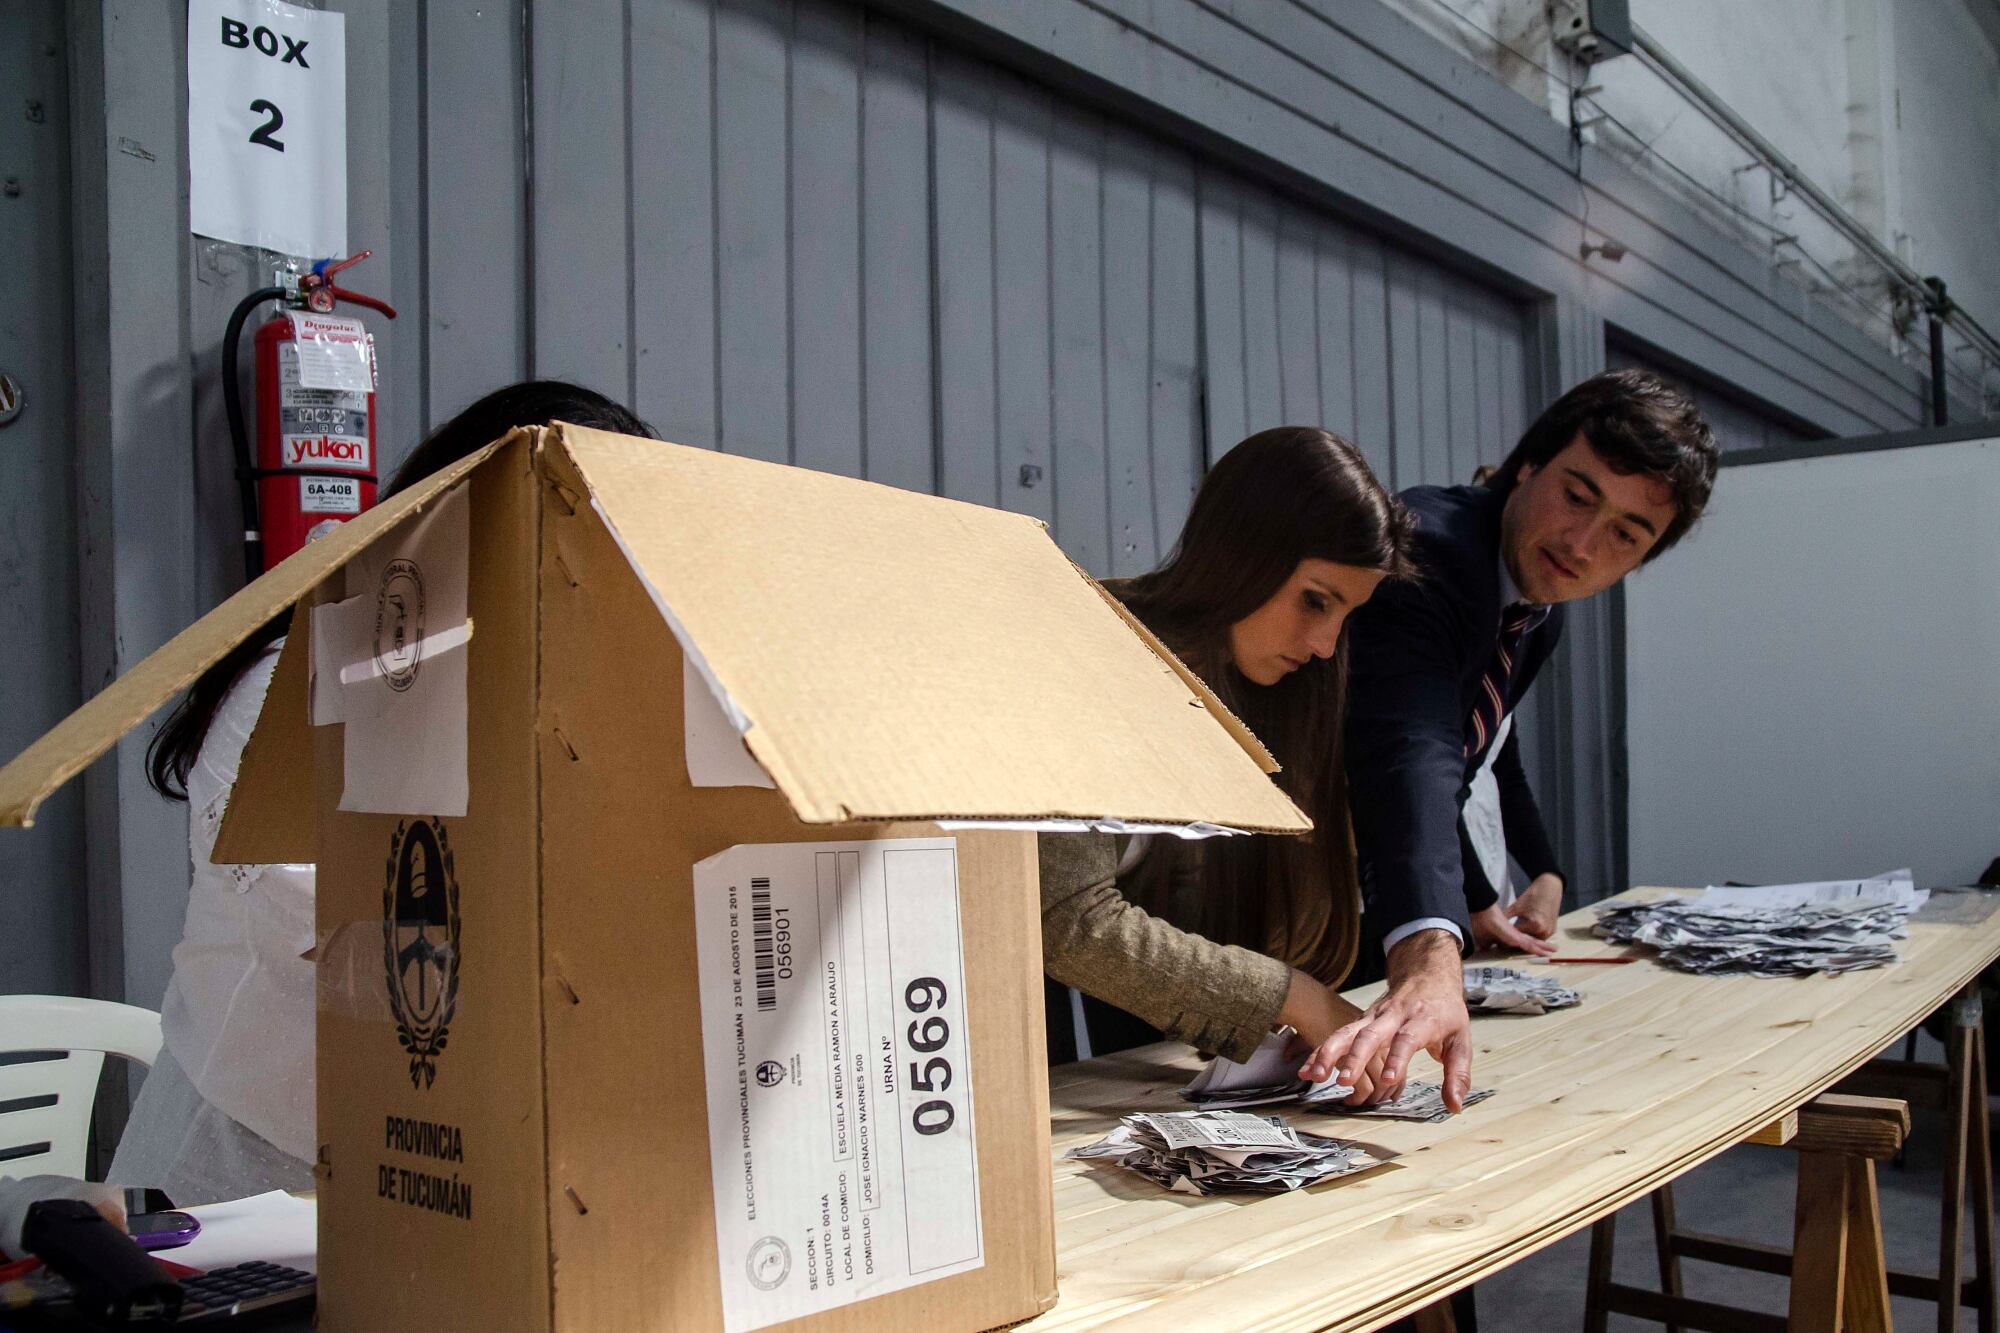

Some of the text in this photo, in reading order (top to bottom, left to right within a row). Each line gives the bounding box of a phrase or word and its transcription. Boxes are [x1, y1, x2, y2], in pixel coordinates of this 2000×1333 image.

[221, 16, 310, 69] BOX
[249, 99, 284, 152] 2
[291, 434, 362, 463] yukon
[308, 484, 352, 495] 6A-40B
[775, 909, 792, 979] 056901
[828, 962, 837, 1006] ARAUJO
[729, 886, 756, 1220] ELECCIONES PROVINCIALES TUCUMÁN 23 DE AGOSTO DE 2015
[832, 1021, 840, 1061] RAMON
[905, 977, 954, 1135] 0569
[834, 1064, 842, 1099] MEDIA
[857, 1076, 866, 1123] WARNES
[884, 1055, 893, 1093] URNA
[386, 1115, 463, 1163] PROVINCIA
[837, 1102, 846, 1154] ESCUELA
[860, 1126, 870, 1172] IGNACIO
[378, 1164, 472, 1220] DE TUCUMÁN
[863, 1175, 872, 1203] JOSE
[821, 1194, 834, 1286] CIRCUITO: 0014A
[839, 1171, 853, 1280] LOCAL DE COMICIO:
[863, 1215, 873, 1274] DOMICILIO:
[808, 1237, 818, 1290] SECCION:
